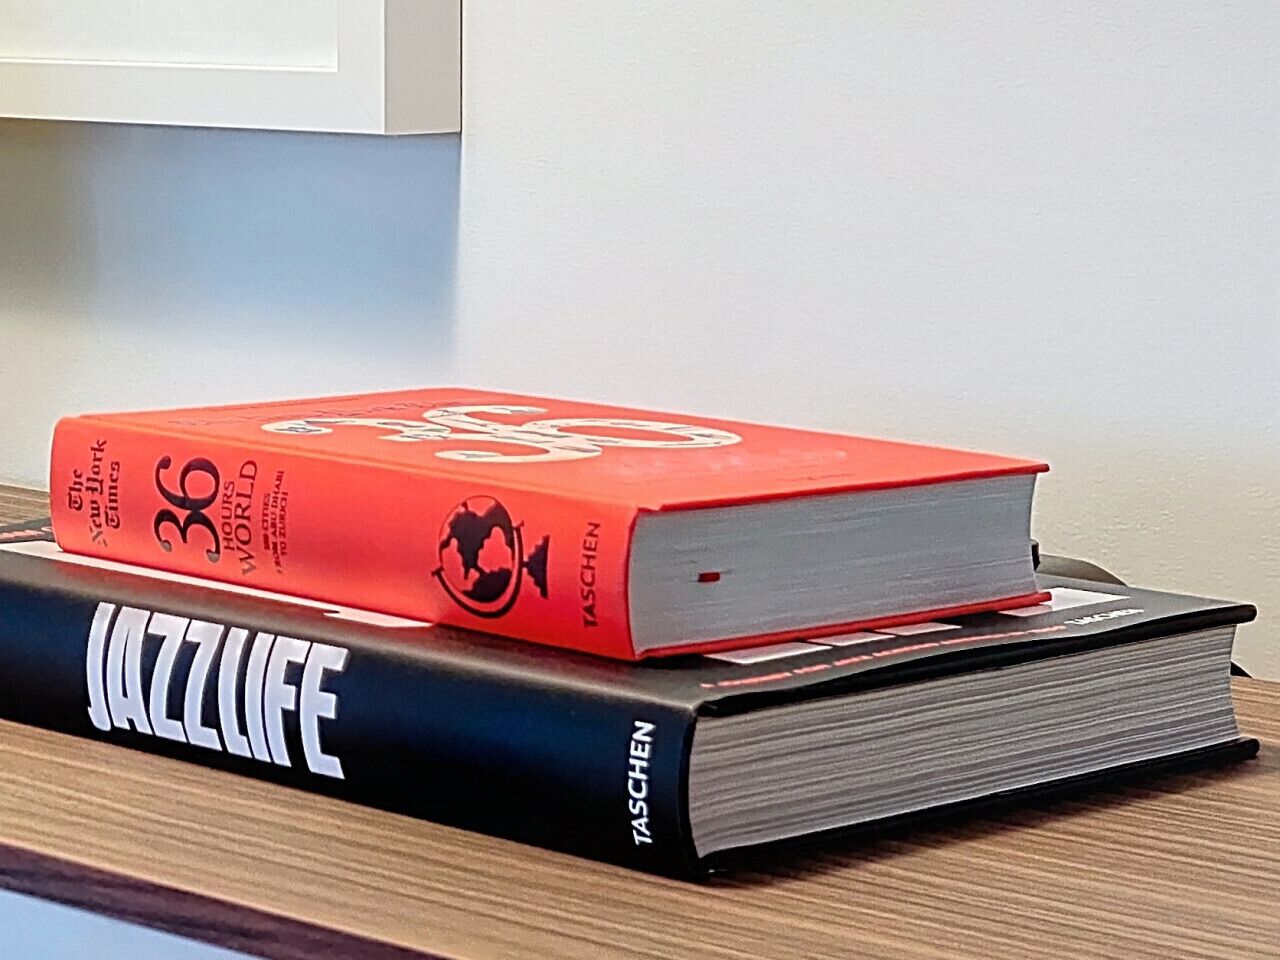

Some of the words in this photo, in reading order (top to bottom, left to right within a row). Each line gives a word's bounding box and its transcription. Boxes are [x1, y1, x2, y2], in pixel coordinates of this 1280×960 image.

[67, 468, 83, 511] The
[86, 439, 107, 496] York
[105, 460, 121, 529] Times
[153, 454, 221, 564] 36
[89, 498, 108, 548] New
[221, 480, 236, 551] HOURS
[235, 459, 258, 576] WORLD
[579, 521, 601, 629] TASCHEN
[87, 600, 350, 780] JAZZLIFE
[628, 720, 658, 846] TASCHEN
